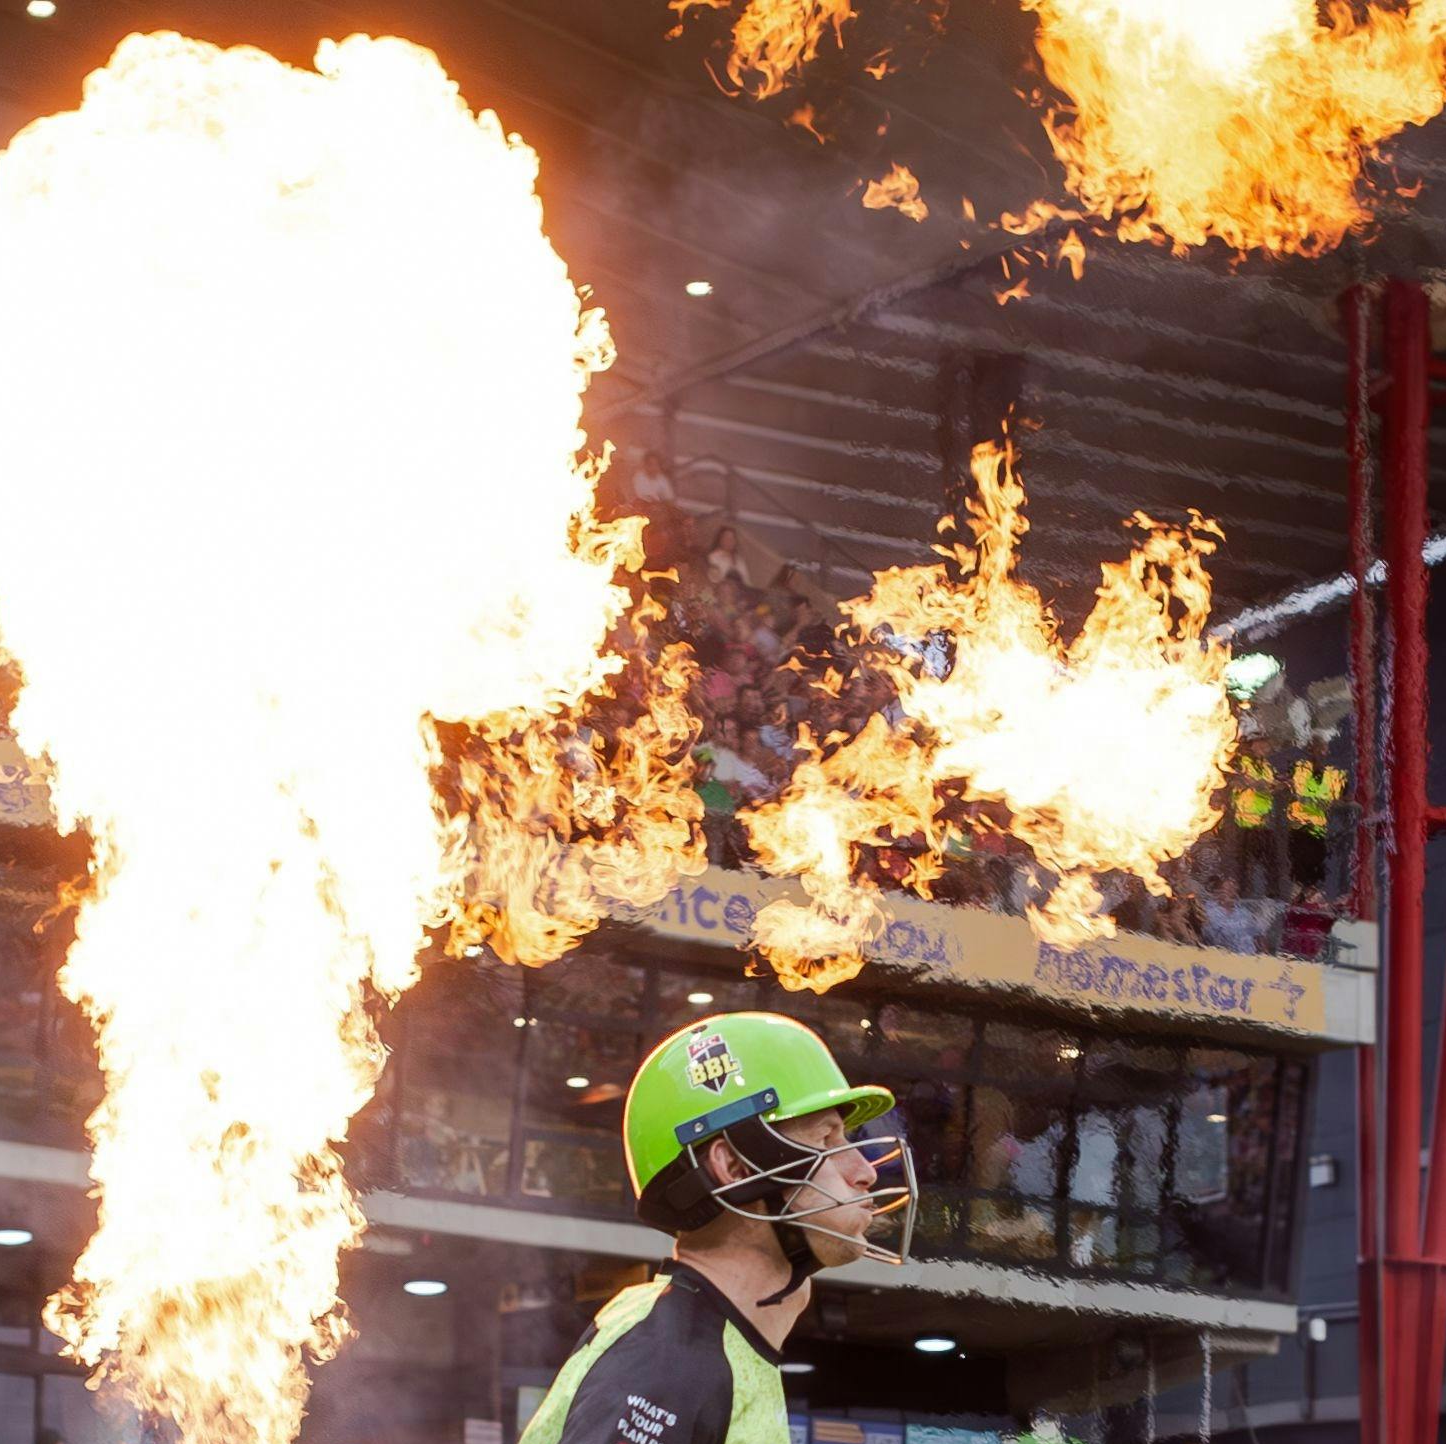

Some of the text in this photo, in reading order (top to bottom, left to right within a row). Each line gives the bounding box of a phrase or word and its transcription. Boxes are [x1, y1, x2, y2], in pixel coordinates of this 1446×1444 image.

[688, 1053, 739, 1087] BBL
[627, 1394, 677, 1427] WHAT'S
[631, 1409, 664, 1437] YOUR
